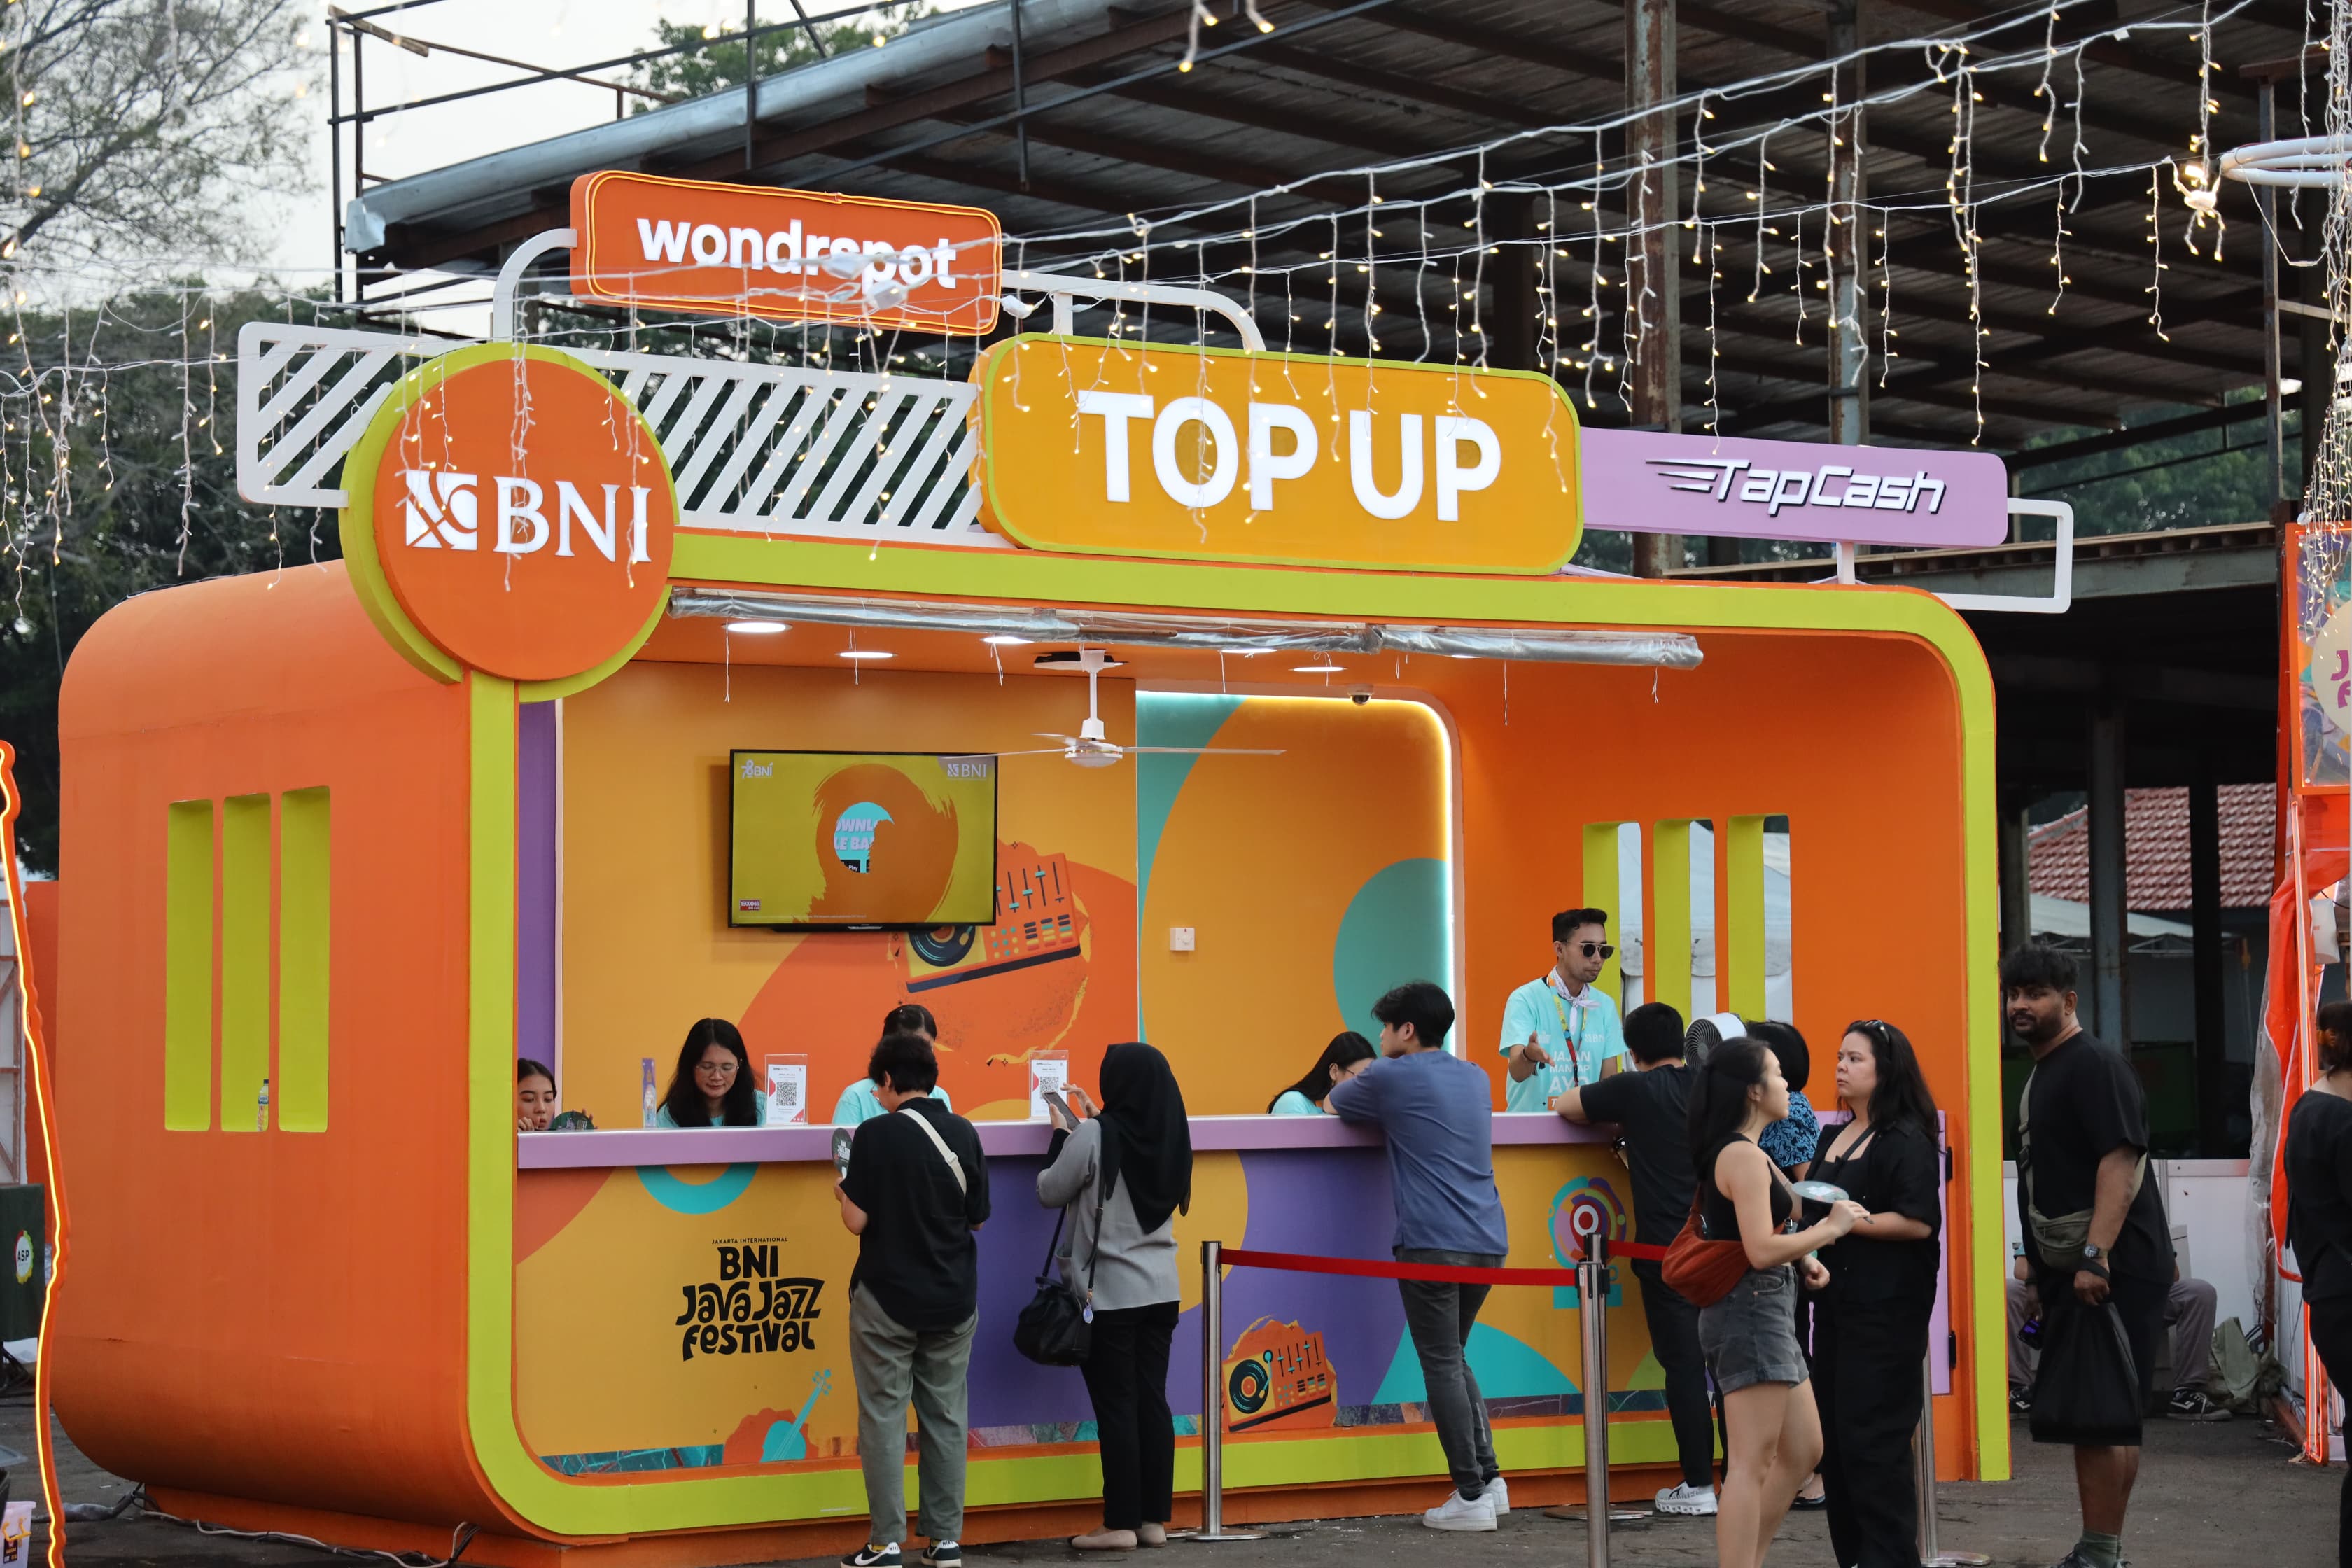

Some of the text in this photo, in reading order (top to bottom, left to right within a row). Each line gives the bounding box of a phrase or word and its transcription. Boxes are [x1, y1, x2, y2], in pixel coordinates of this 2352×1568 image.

[1078, 389, 1501, 522] TOP UP
[1645, 458, 1947, 517] TapCash
[493, 476, 652, 562] BNI
[962, 764, 986, 778] BNI
[1550, 1063, 1590, 1073] MANAP
[18, 1250, 29, 1261] ASP
[717, 1245, 778, 1281] BNI
